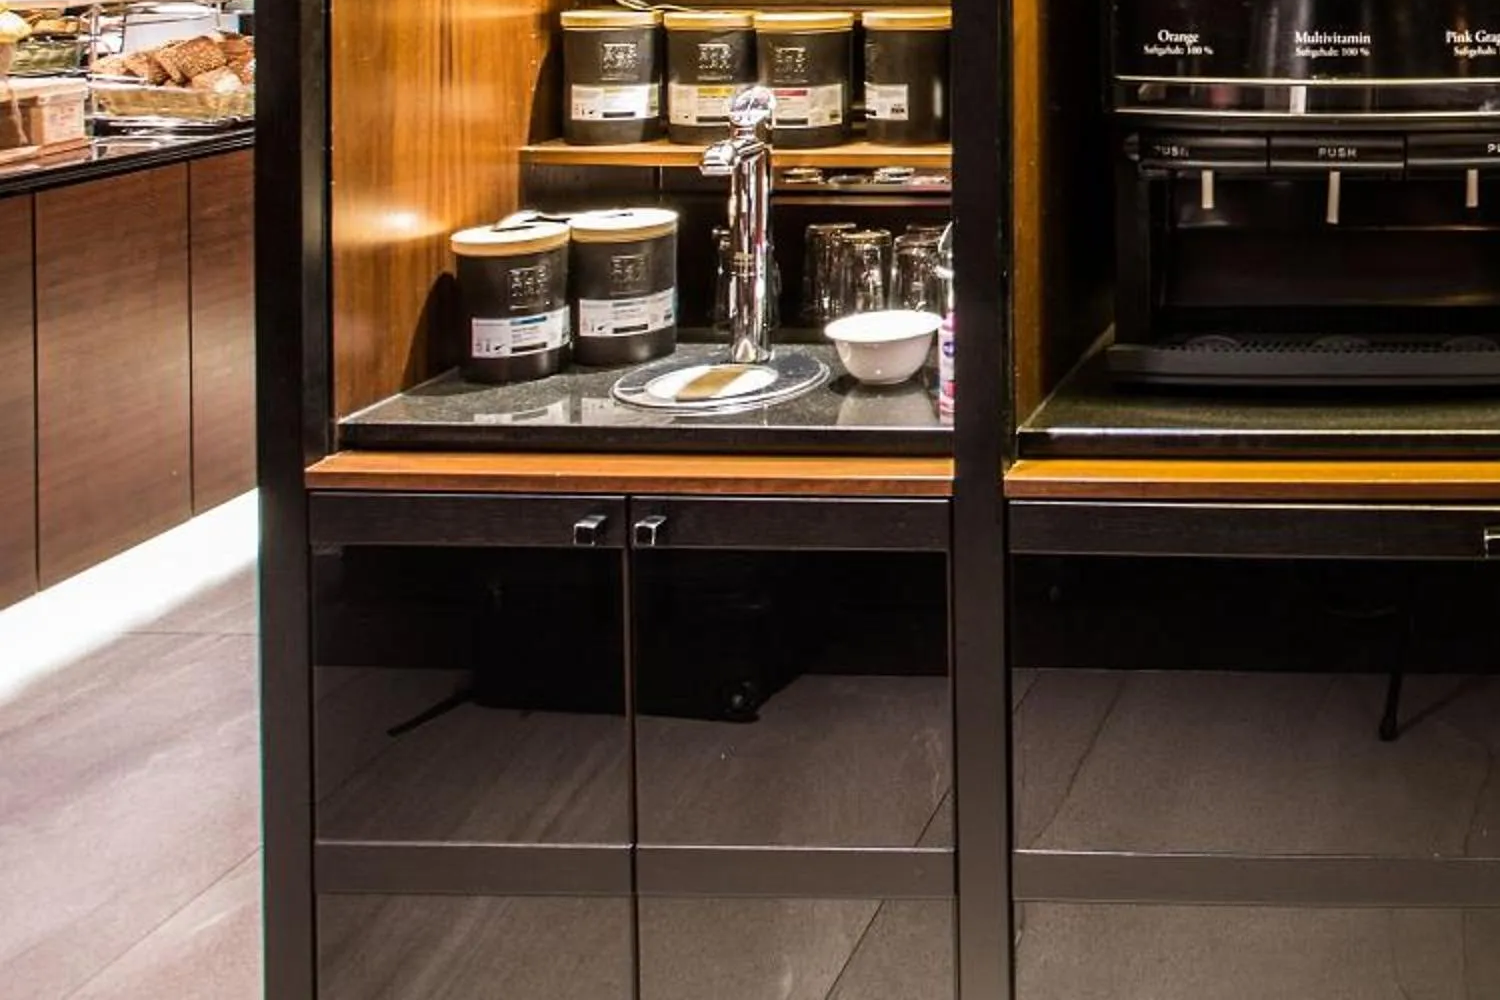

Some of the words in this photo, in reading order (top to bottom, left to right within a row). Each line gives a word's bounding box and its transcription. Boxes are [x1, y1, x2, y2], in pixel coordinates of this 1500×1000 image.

[1157, 29, 1199, 46] Orange
[1295, 31, 1371, 44] Multivitamin
[1445, 29, 1472, 43] Pink
[1317, 146, 1358, 158] PUSH
